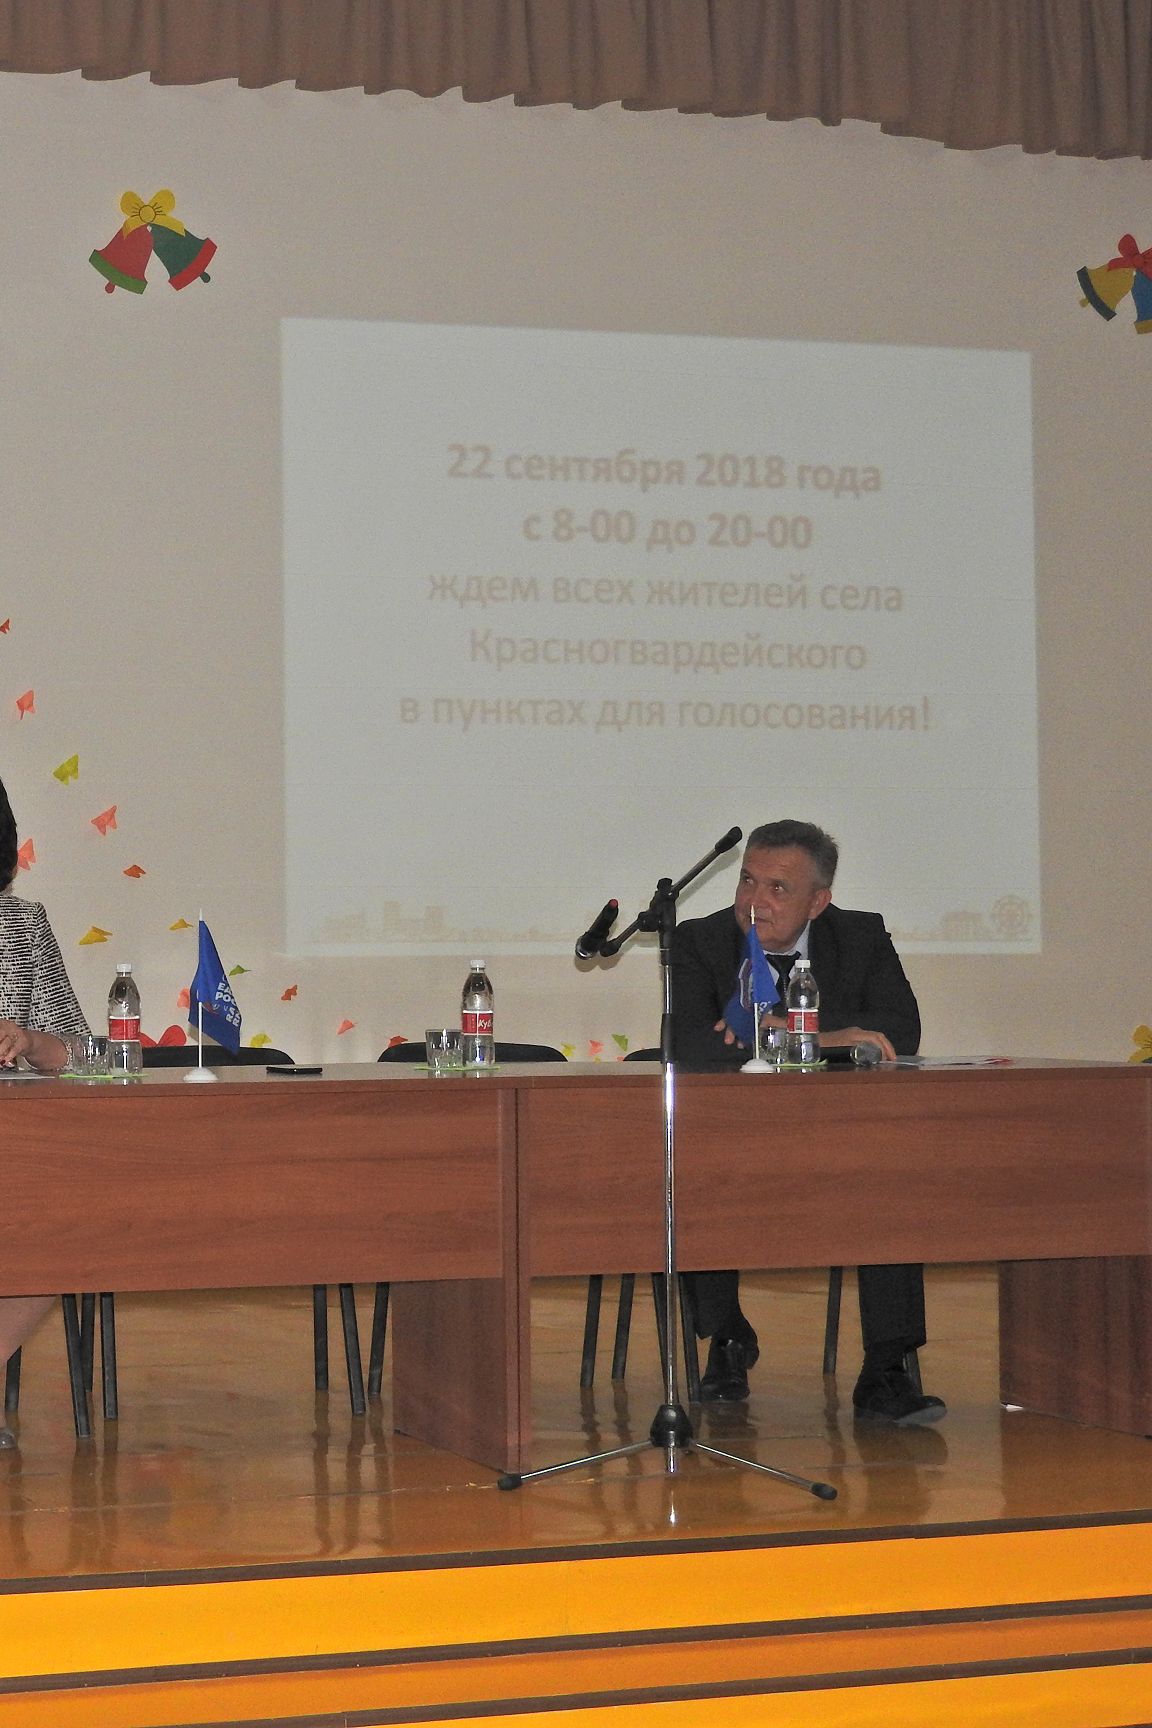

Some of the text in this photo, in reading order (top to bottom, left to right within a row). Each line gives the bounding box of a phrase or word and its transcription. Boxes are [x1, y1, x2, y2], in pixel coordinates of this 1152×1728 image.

[446, 443, 882, 499] 22 сентября 2018 года
[522, 508, 813, 552] с 8-00 до 20-00
[427, 575, 903, 612] ждем всех жителей села
[469, 630, 867, 673] Красногвардейского
[399, 696, 930, 732] в пунктах для голосования!
